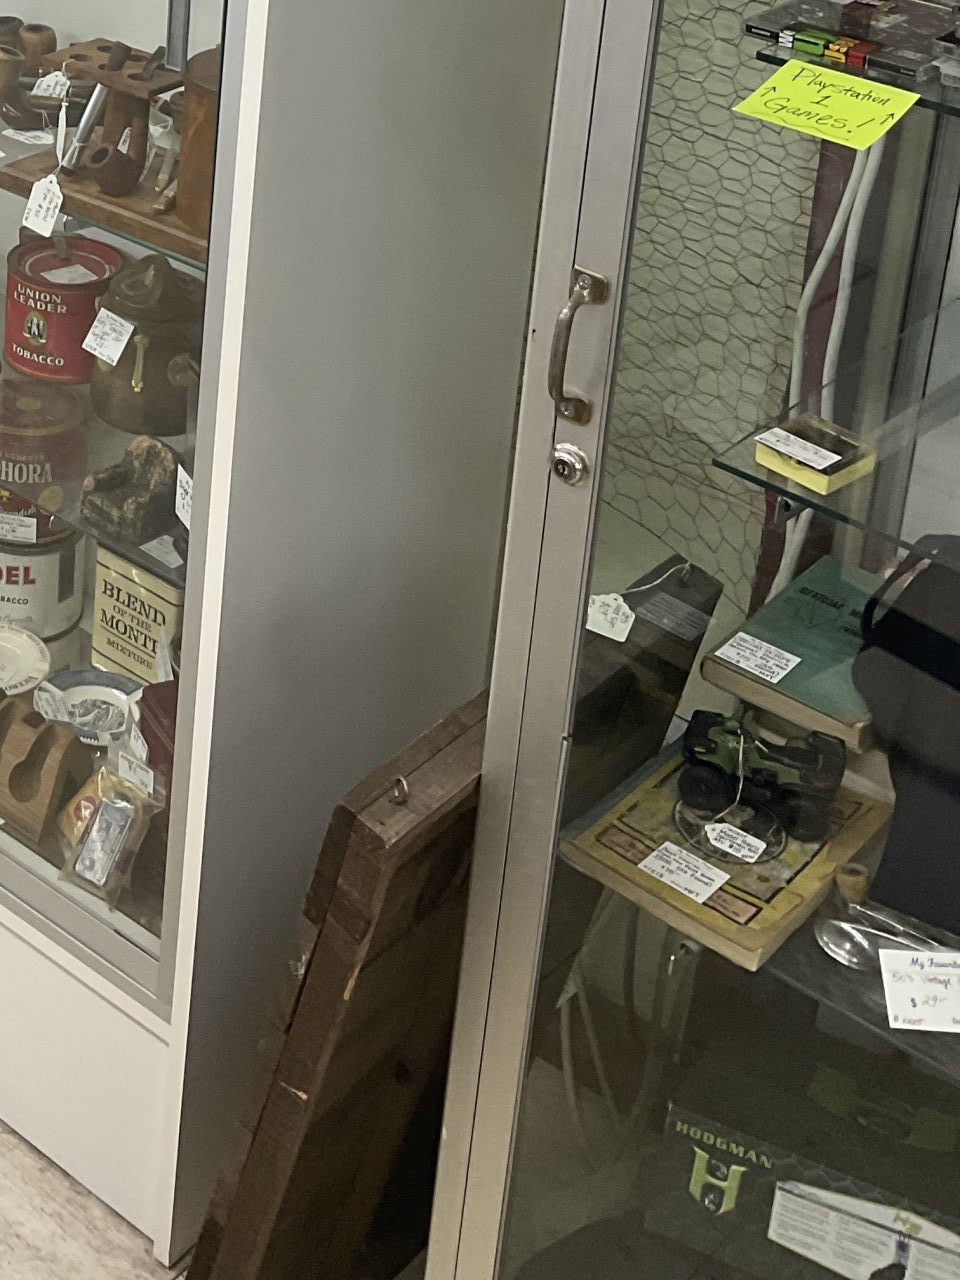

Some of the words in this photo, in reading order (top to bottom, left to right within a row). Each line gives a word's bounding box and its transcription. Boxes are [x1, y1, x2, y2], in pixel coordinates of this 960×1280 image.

[792, 66, 892, 107] Playstation
[809, 94, 830, 108] 1
[14, 290, 68, 314] LEADER
[17, 283, 62, 303] UNION
[11, 342, 65, 366] TOBACCO
[102, 578, 166, 627] BLEND
[113, 604, 127, 618] OF
[129, 613, 152, 632] THE
[107, 637, 153, 670] MIXTURE
[675, 1119, 773, 1169] HODGMAN
